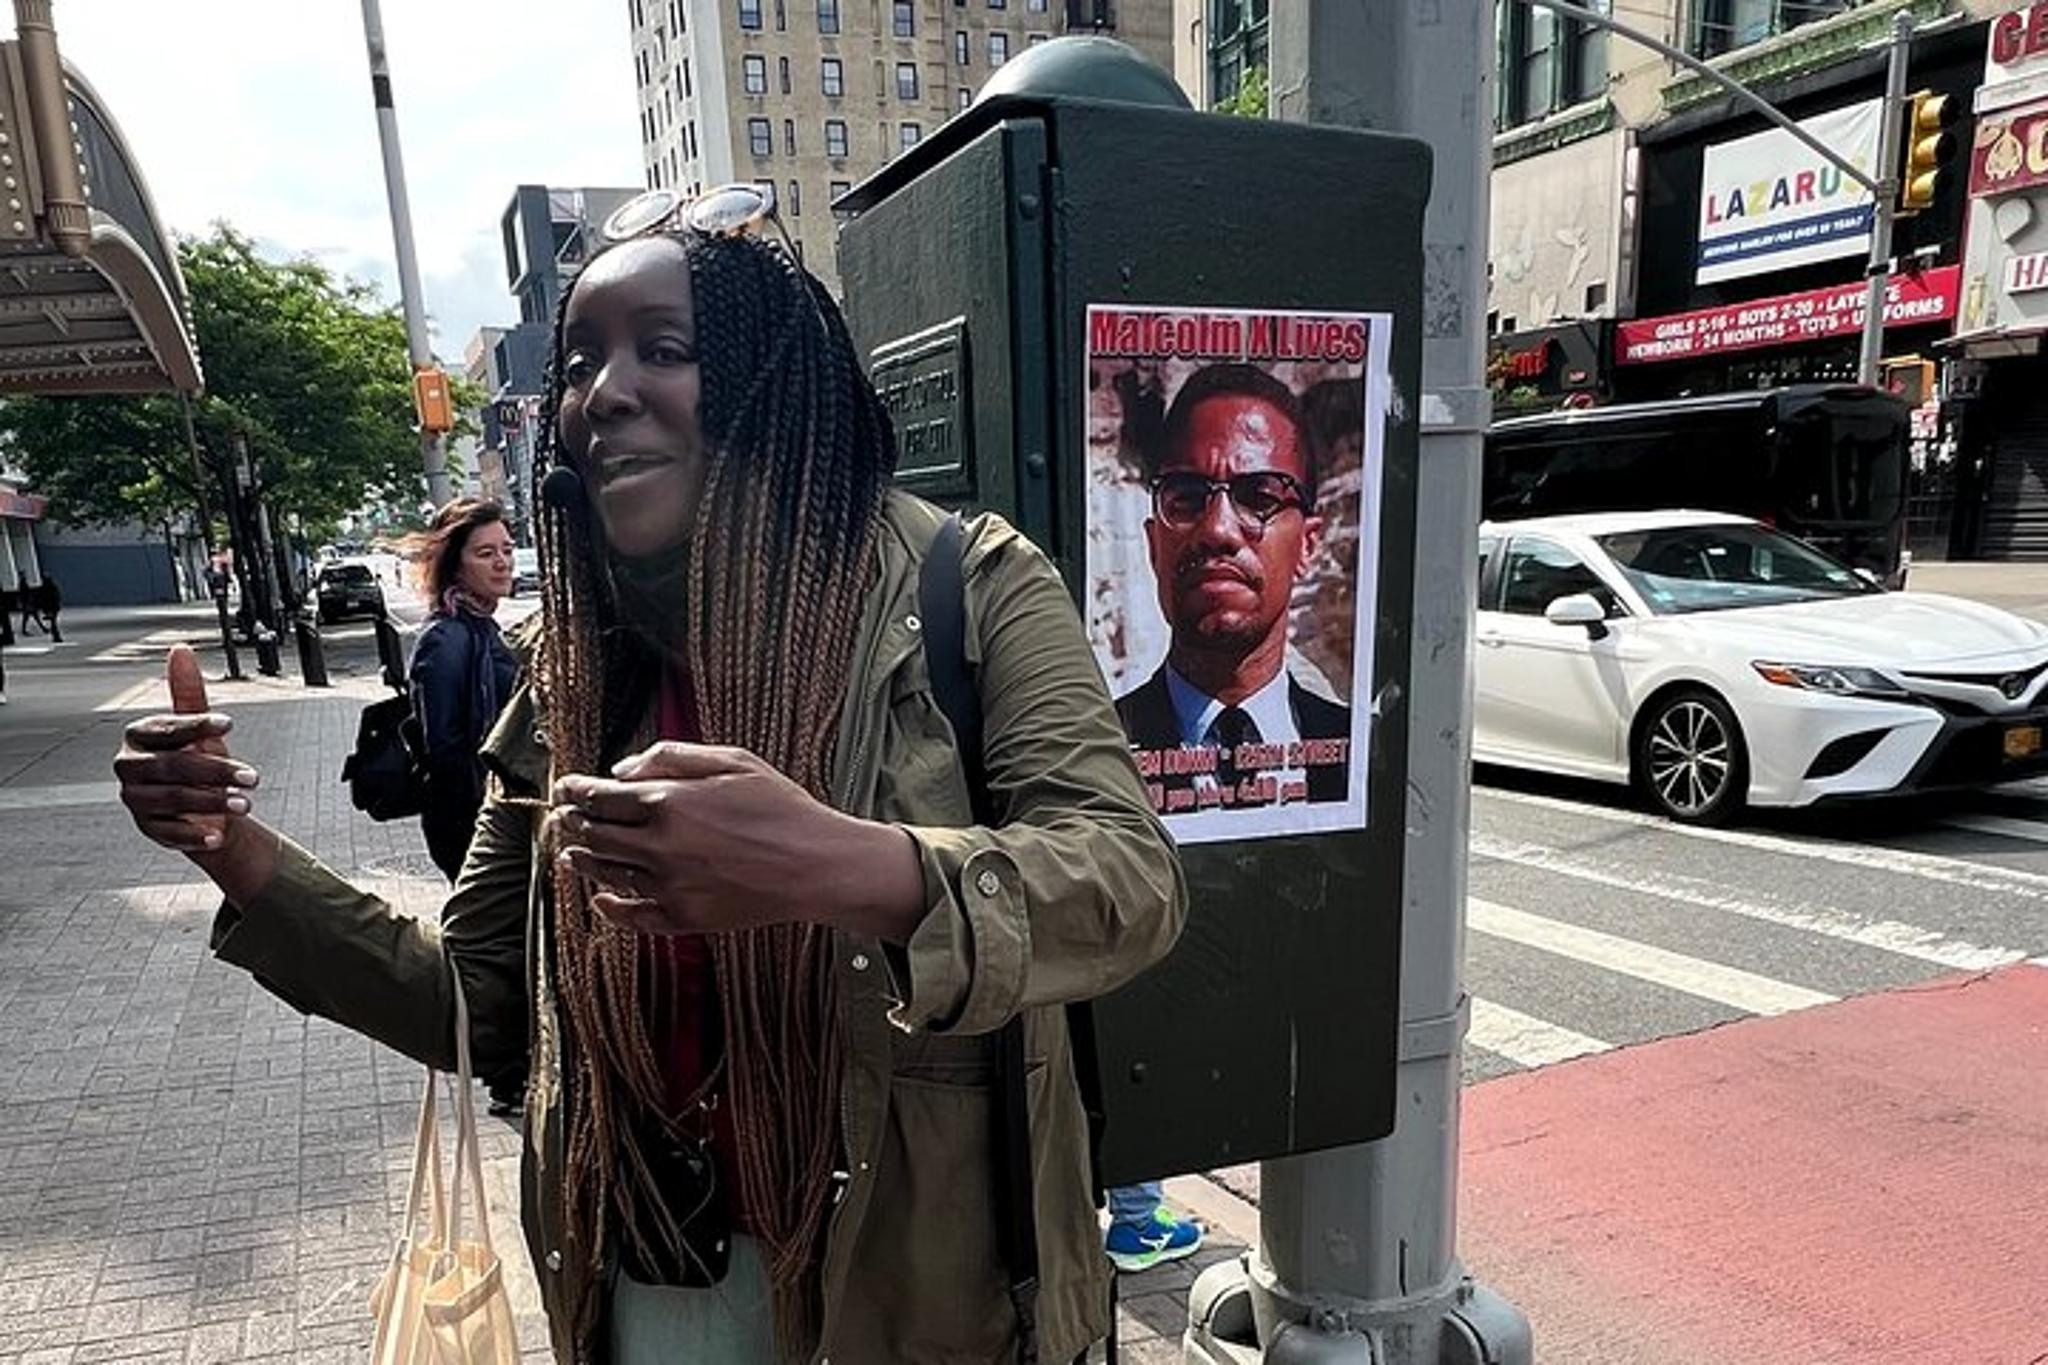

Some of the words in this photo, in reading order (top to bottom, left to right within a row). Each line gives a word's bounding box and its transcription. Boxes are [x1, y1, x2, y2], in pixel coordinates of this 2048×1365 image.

[1089, 310, 1243, 356] Malcolm
[1249, 315, 1273, 357] X
[1275, 317, 1367, 360] Lives
[1626, 337, 1694, 360] NEWBORN
[1703, 333, 1719, 349] 24
[1723, 322, 1785, 345] MONTHS
[1797, 313, 1839, 335] TOYS
[1851, 296, 1945, 326] UFORMS
[1655, 320, 1695, 339] GIRLS
[1737, 306, 1778, 326] BOYS
[1826, 284, 1901, 313] LAYEE
